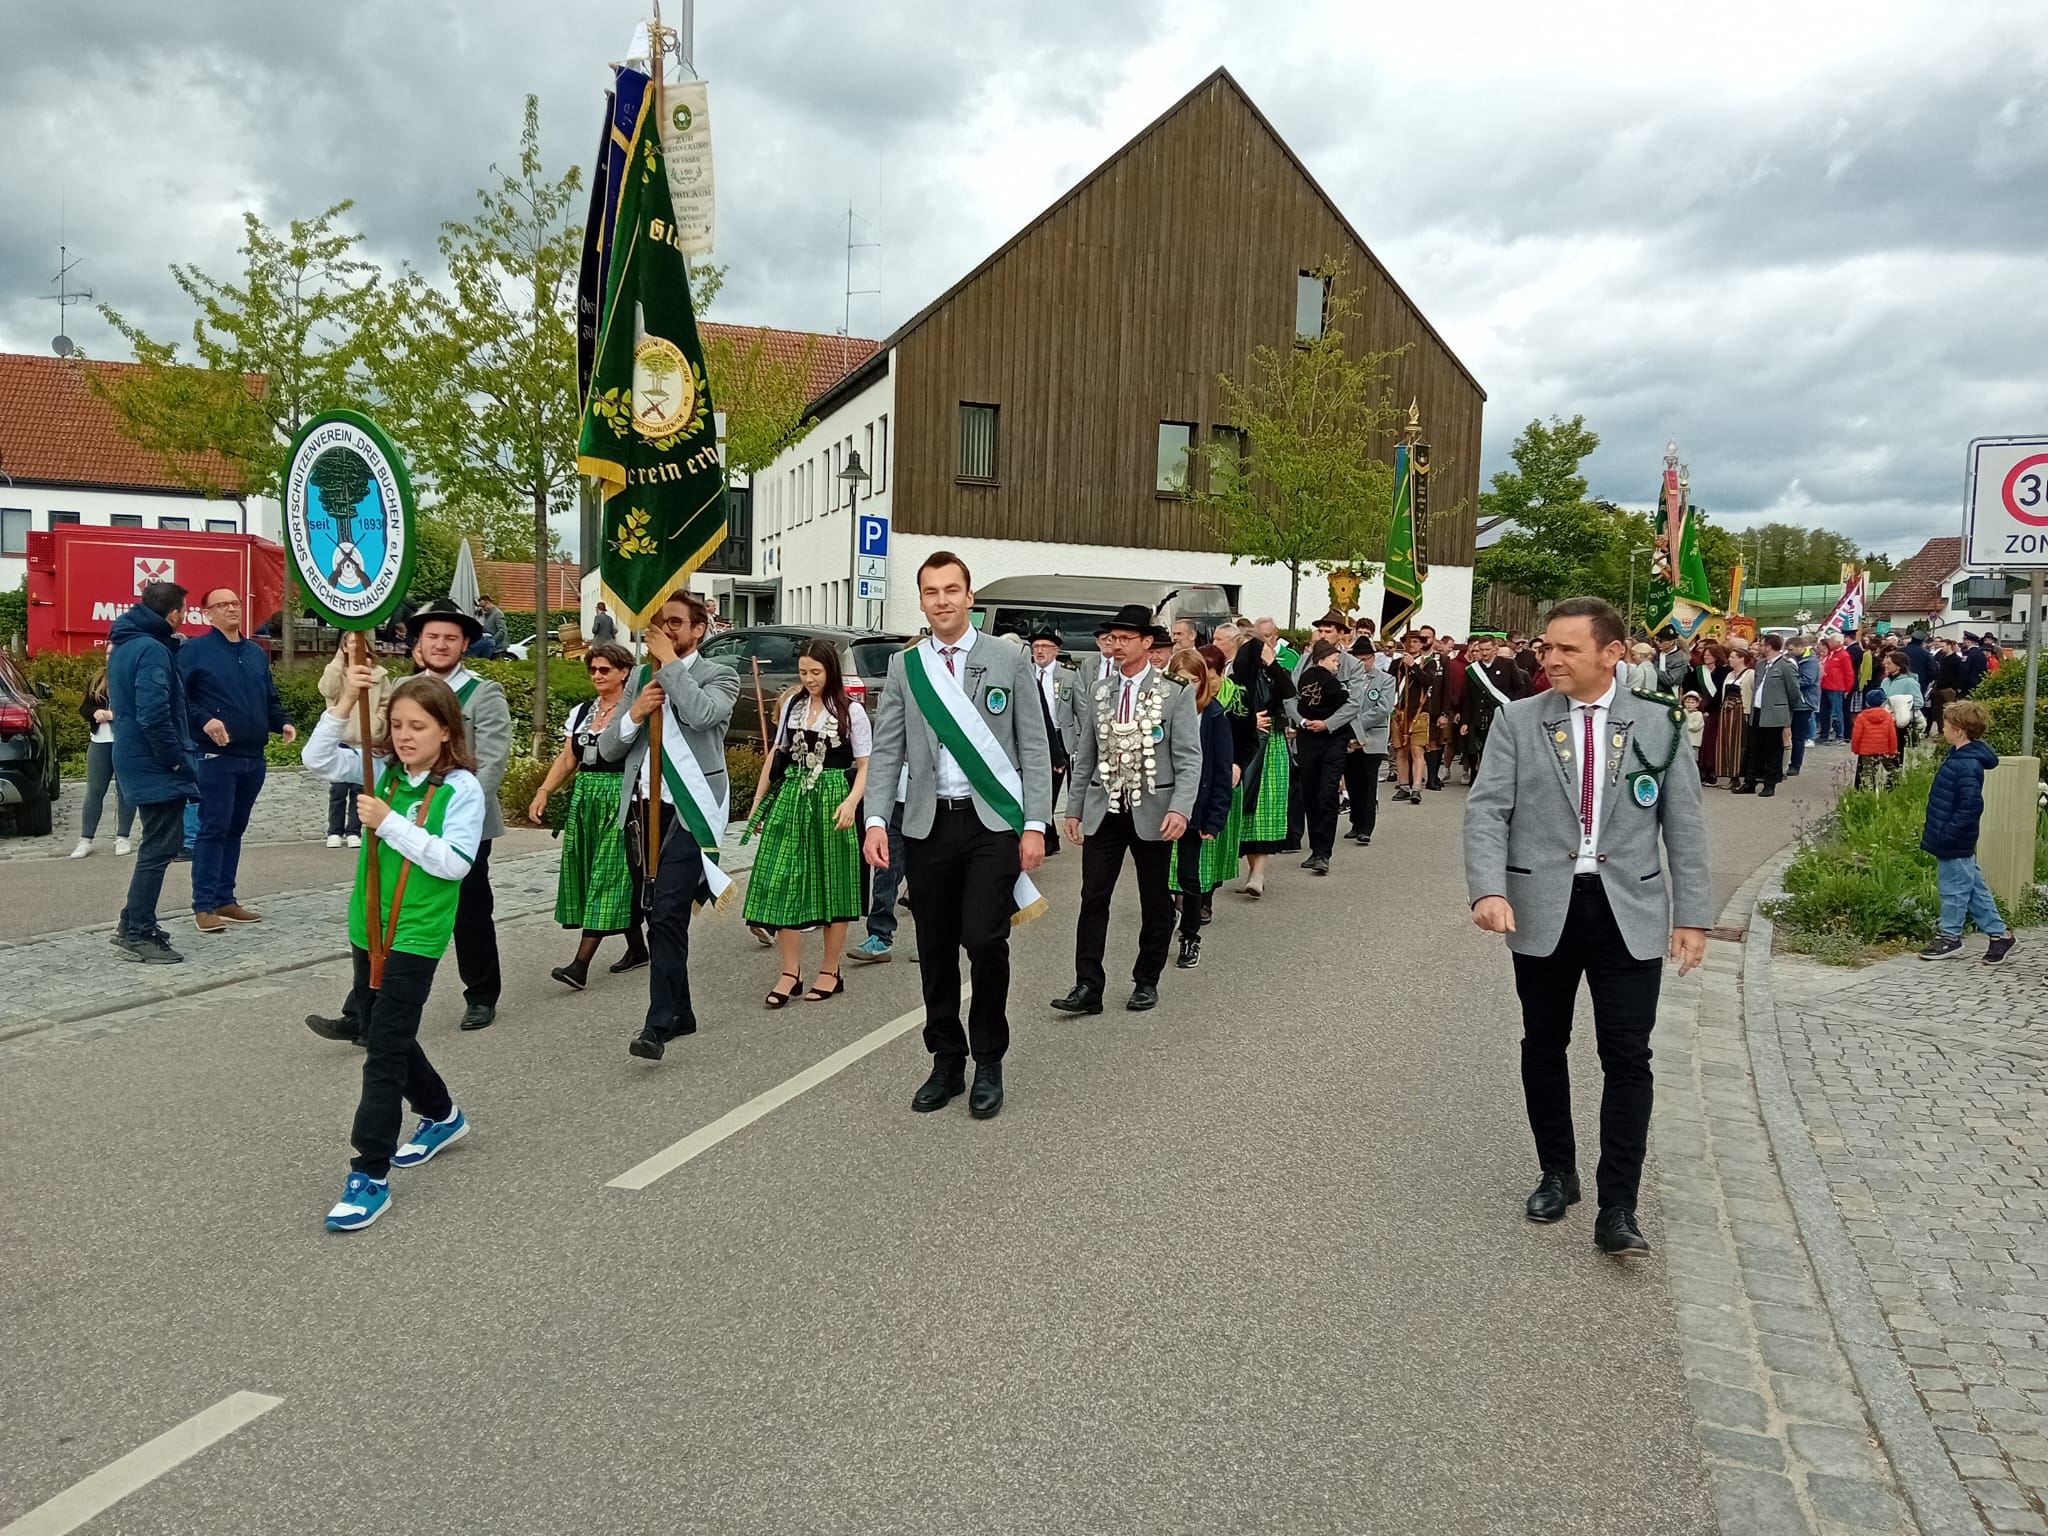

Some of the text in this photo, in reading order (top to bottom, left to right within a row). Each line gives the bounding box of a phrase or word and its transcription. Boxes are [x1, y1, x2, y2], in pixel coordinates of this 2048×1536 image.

[2019, 474, 2048, 507] 3
[309, 517, 382, 530] seit 1893
[865, 520, 882, 551] P
[305, 565, 394, 612] REICHERTSHAUSEN
